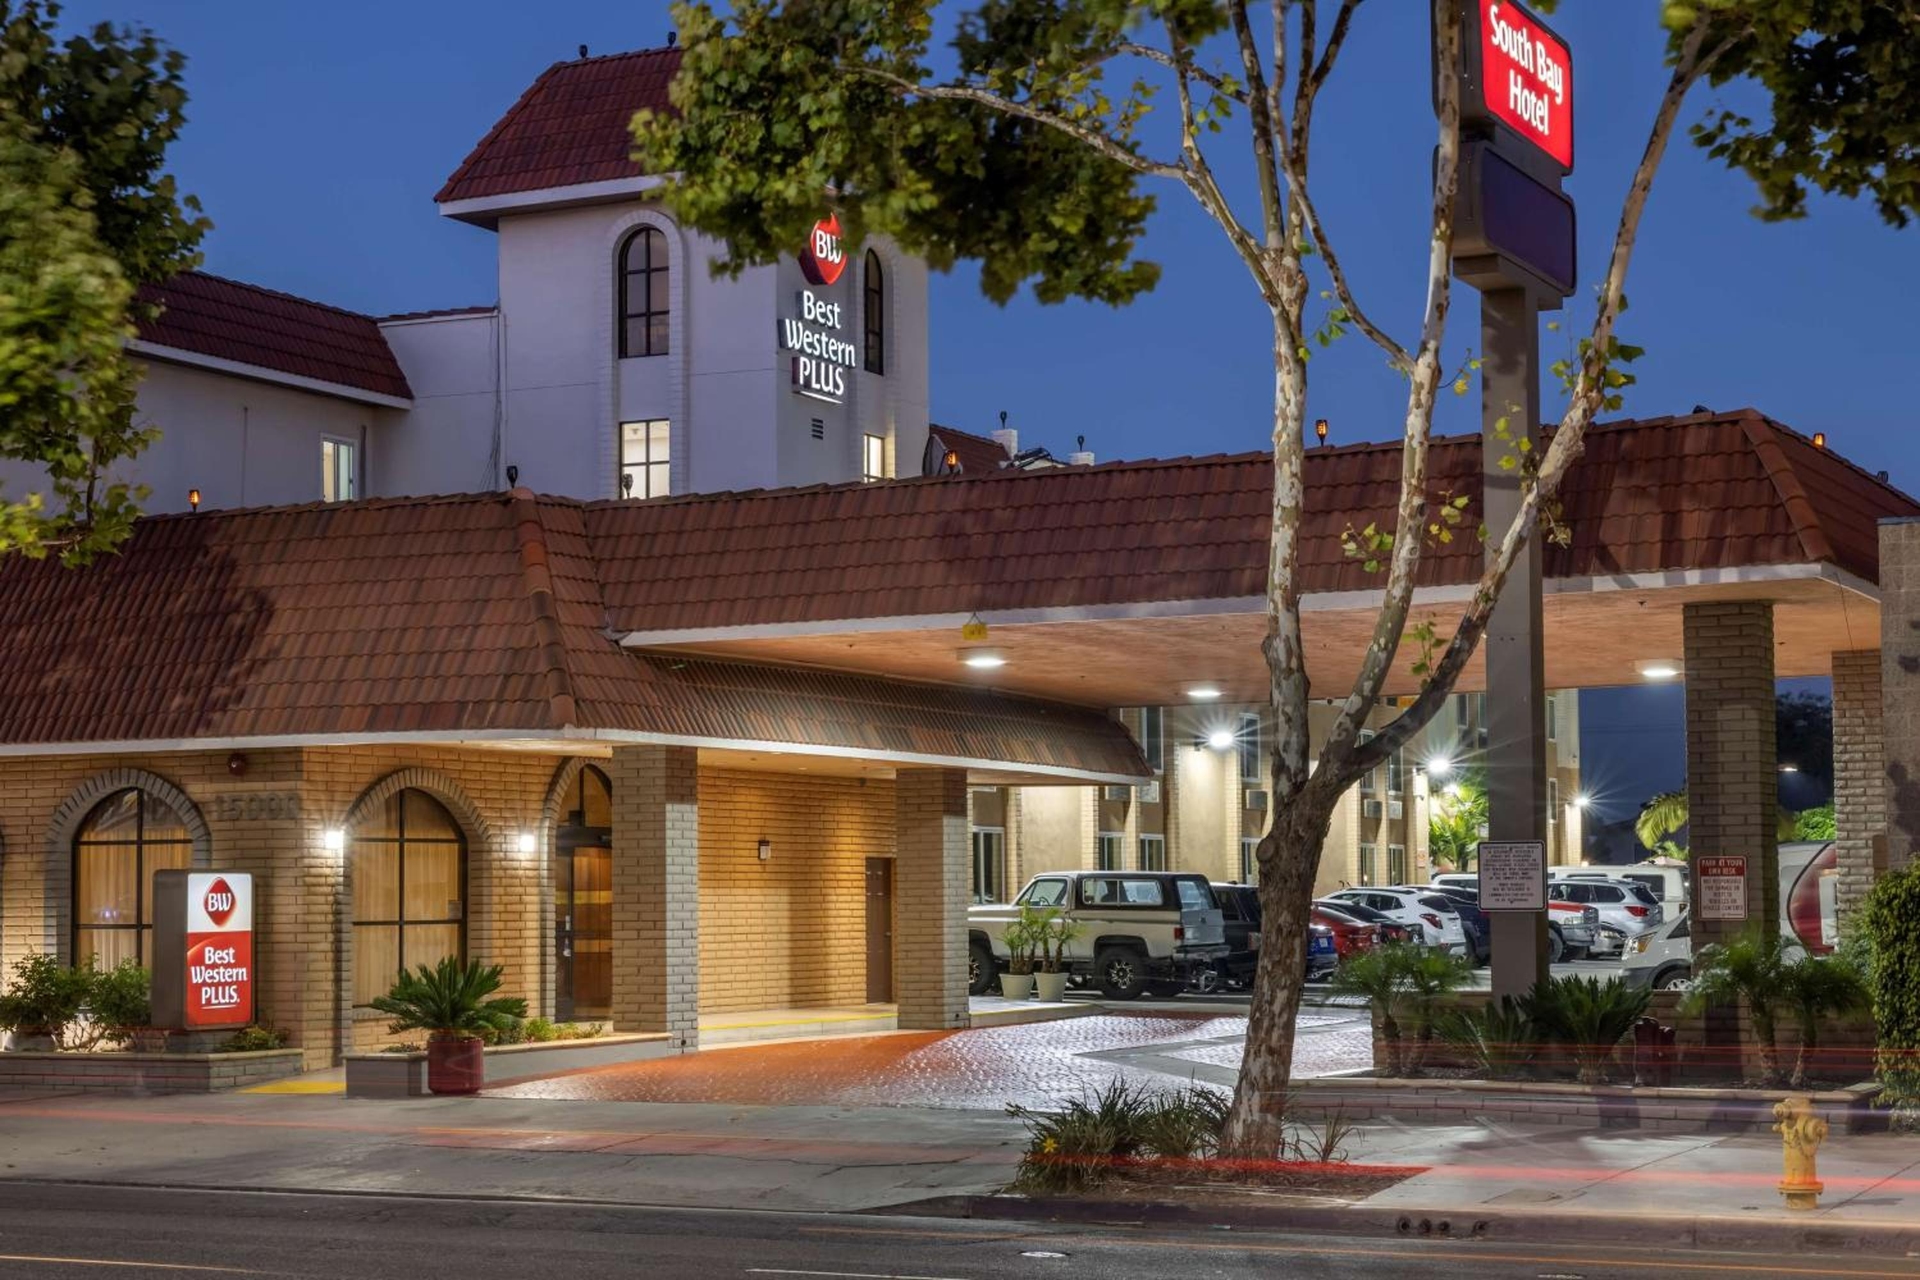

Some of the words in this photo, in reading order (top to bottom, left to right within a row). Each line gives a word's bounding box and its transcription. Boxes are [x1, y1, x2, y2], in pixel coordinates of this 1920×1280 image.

[1490, 4, 1534, 73] South
[1536, 40, 1562, 105] Bay
[1509, 68, 1549, 136] Hotel
[816, 230, 842, 264] BW
[803, 290, 841, 329] Best
[785, 318, 856, 367] Western
[800, 356, 844, 396] PLUS
[208, 893, 232, 912] BW
[191, 965, 247, 984] Western
[204, 946, 235, 965] Best
